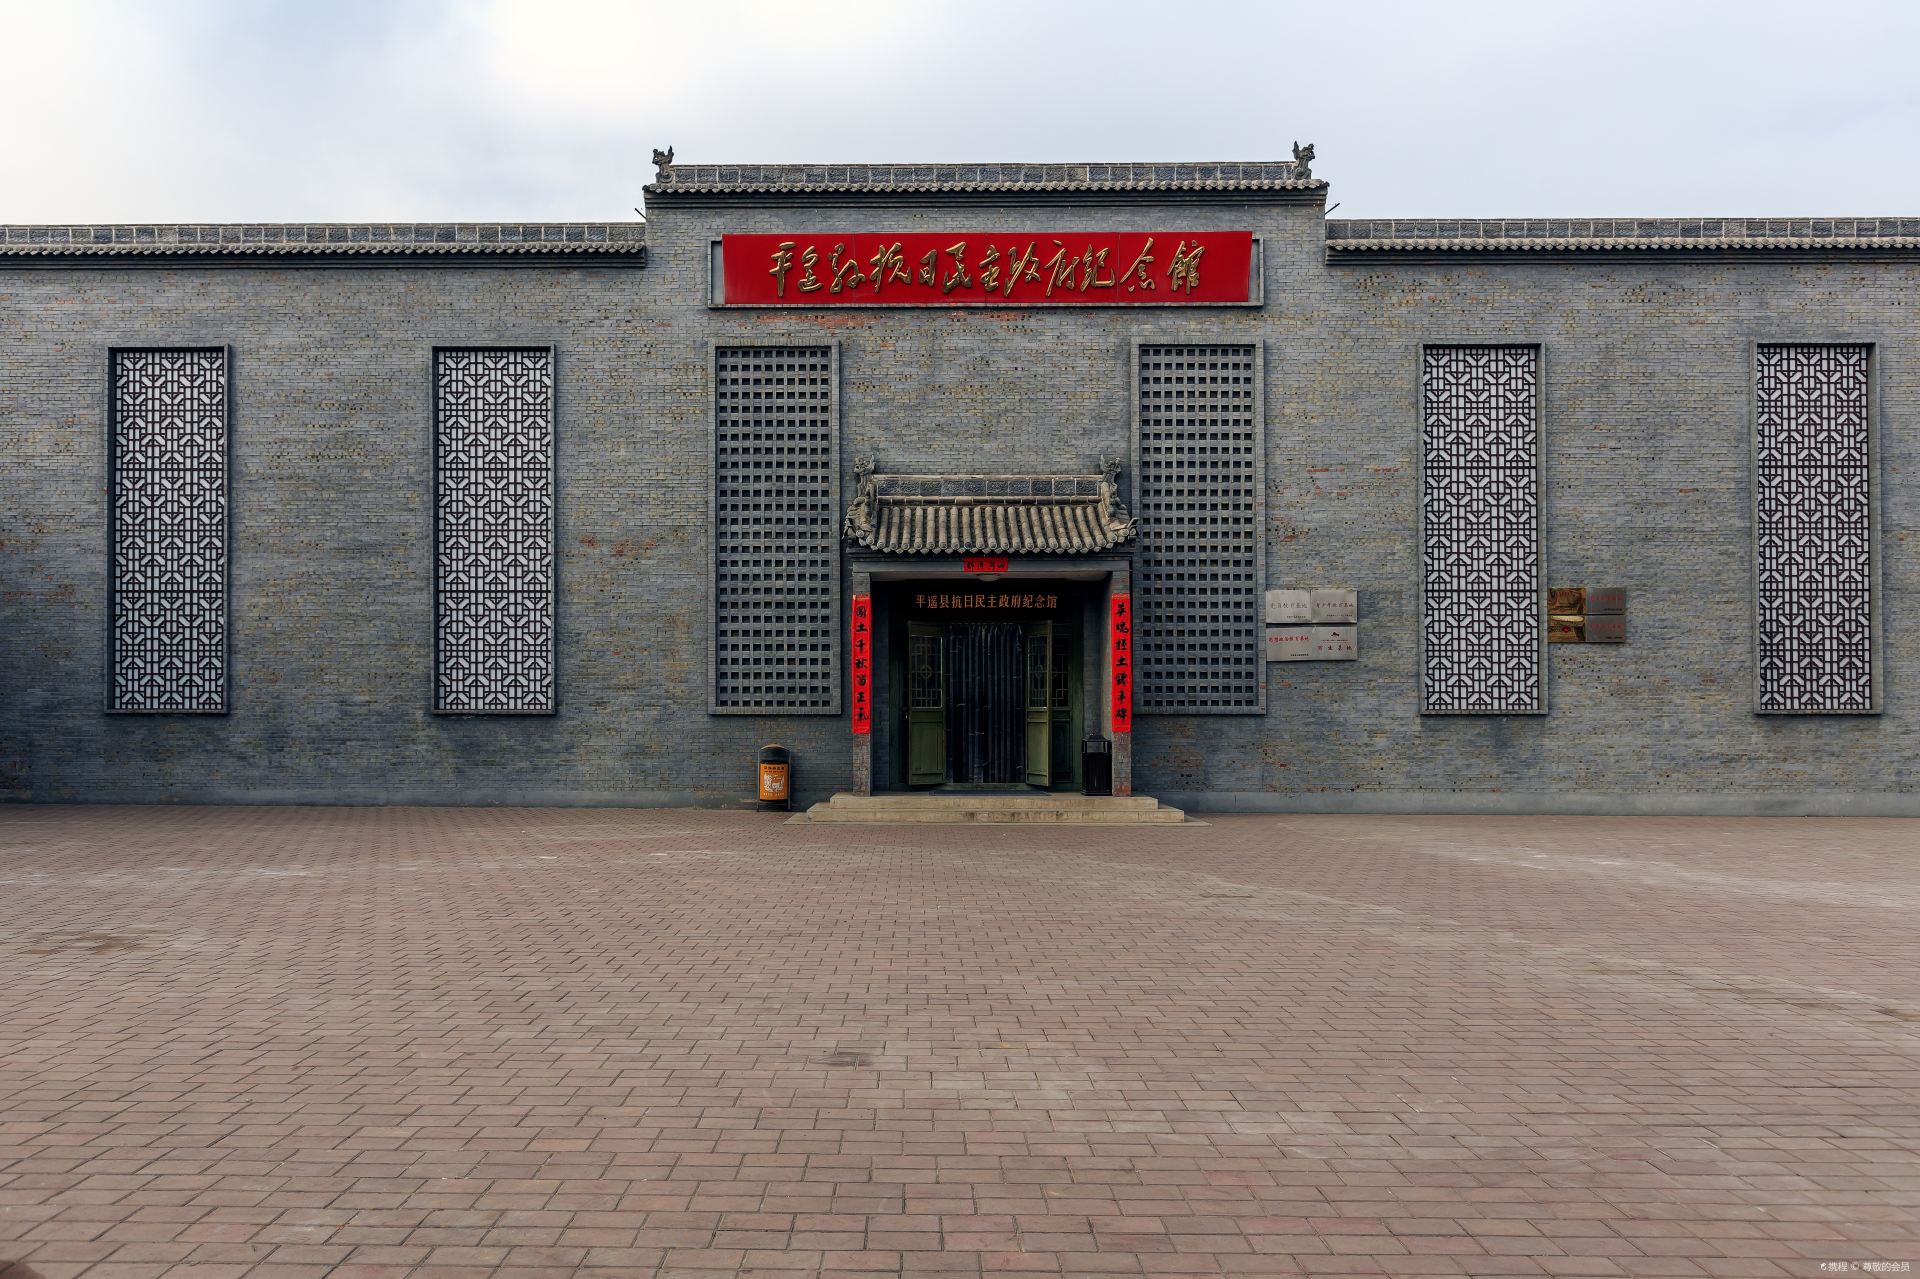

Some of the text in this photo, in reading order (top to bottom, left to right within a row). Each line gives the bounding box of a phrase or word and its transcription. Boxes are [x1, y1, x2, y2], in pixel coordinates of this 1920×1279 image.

[915, 594, 1058, 609] 平遥县抗日民主政府纪念馆
